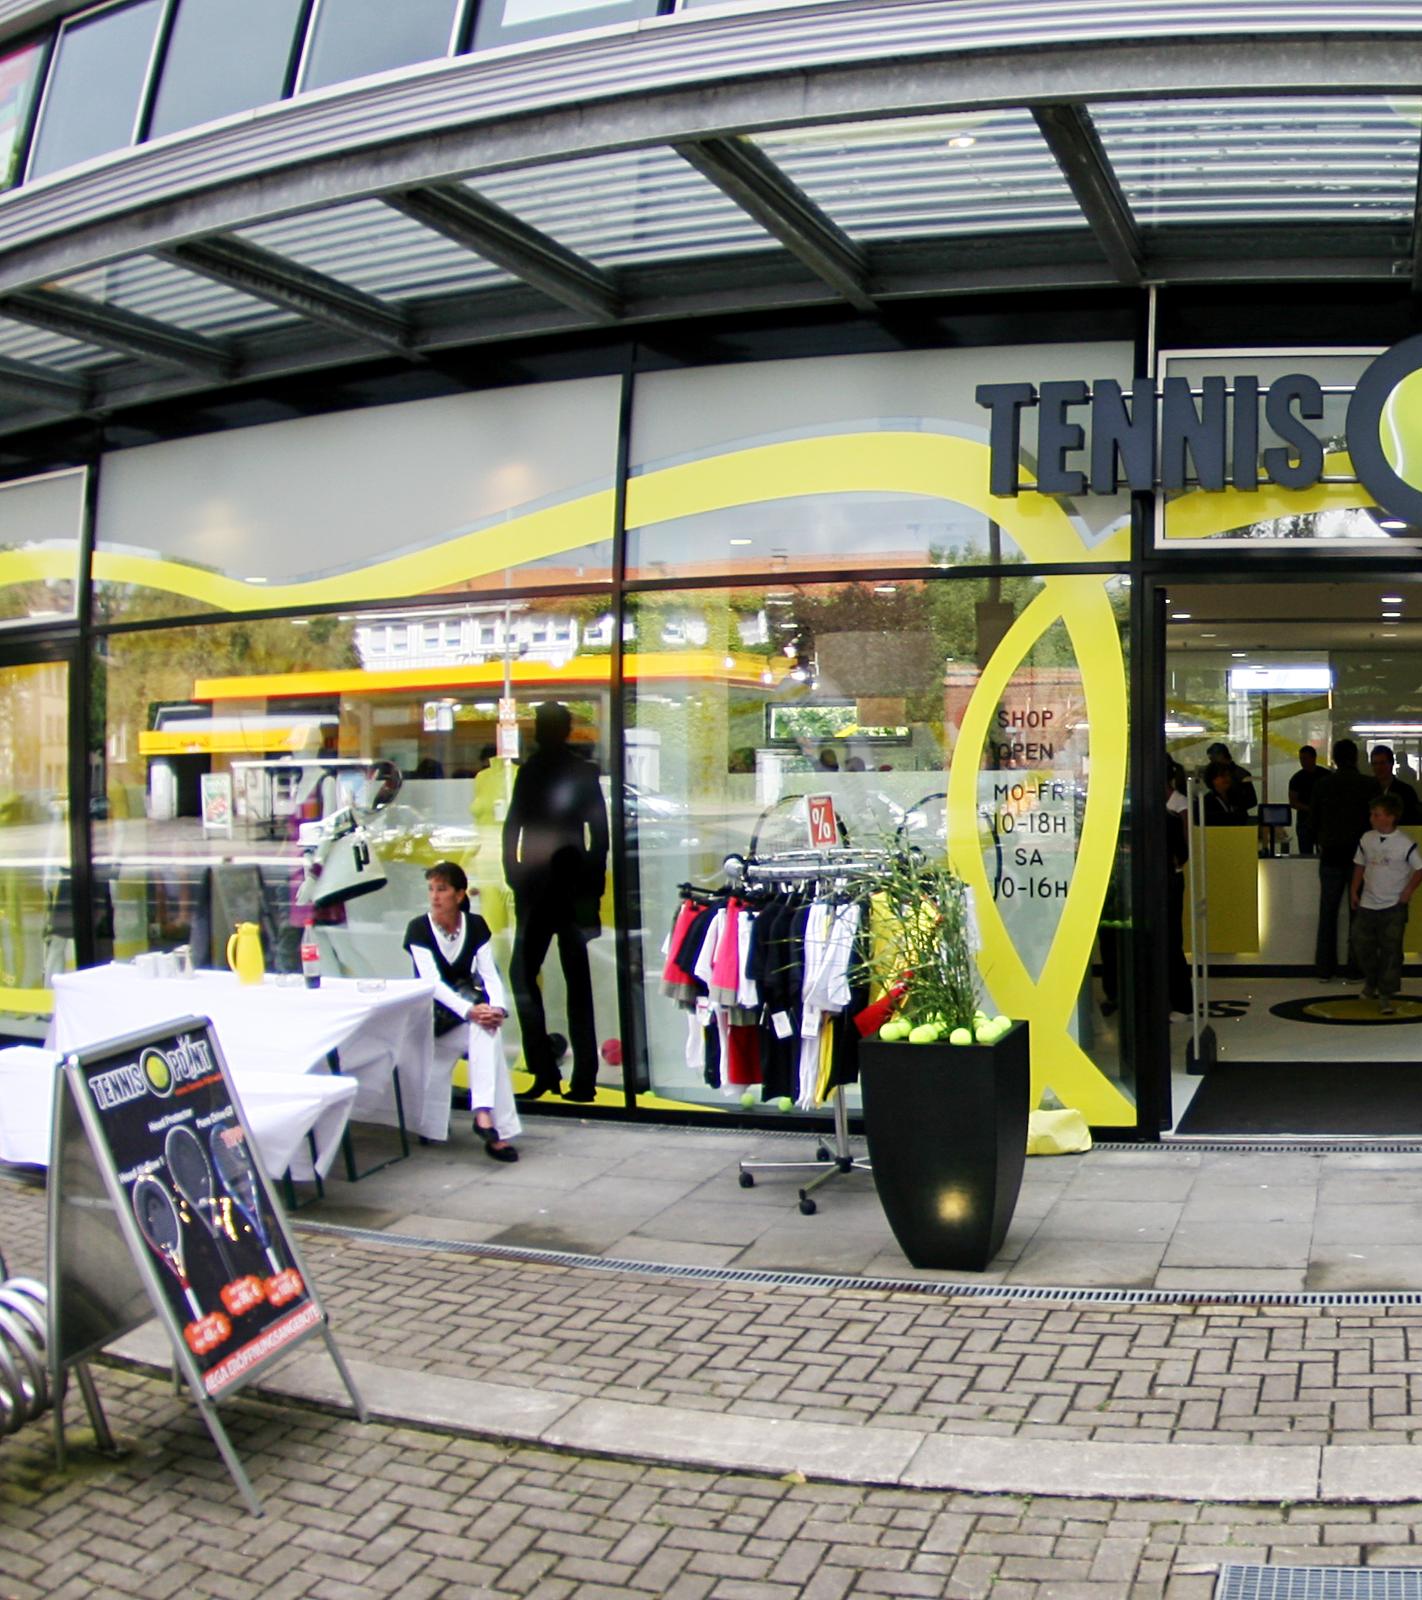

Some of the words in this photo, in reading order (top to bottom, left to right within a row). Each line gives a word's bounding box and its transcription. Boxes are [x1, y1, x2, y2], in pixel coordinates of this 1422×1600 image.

[976, 374, 1325, 499] TENNIS
[997, 710, 1053, 728] SHOP
[999, 743, 1054, 761] OPEN
[993, 783, 1065, 801] MO-FR
[1014, 848, 1044, 866] SA
[88, 1062, 148, 1110] TENNIS
